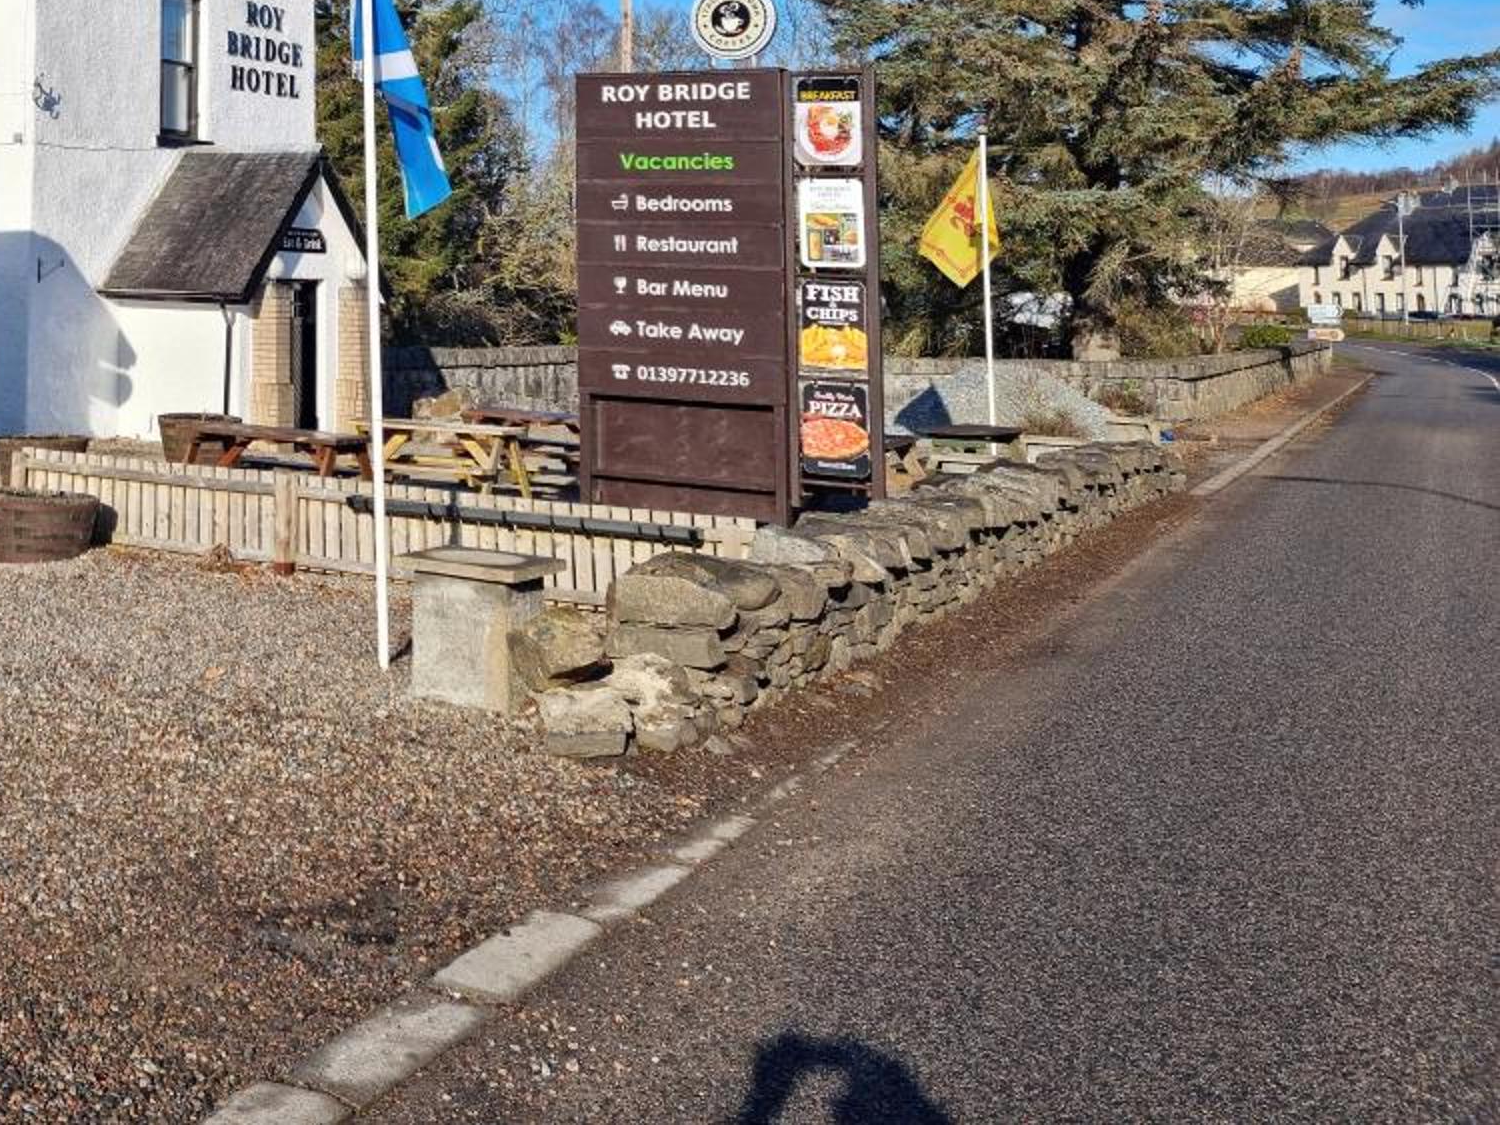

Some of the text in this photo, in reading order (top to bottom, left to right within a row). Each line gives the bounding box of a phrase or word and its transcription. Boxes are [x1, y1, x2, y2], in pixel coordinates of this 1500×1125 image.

[245, 1, 285, 33] ROY
[227, 30, 303, 68] BRIDGE
[231, 65, 299, 99] HOTEL
[602, 81, 751, 103] ROY BRIDGE
[800, 90, 856, 101] BREAKFAST
[635, 110, 717, 129] HOTEL
[619, 152, 735, 170] Vacancies
[635, 194, 734, 213] Bedrooms
[636, 235, 739, 254] Restaurant
[636, 278, 728, 298] Bar Menu
[805, 284, 860, 303] FISH
[806, 307, 859, 322] CHIPS
[636, 321, 745, 345] Take Away
[637, 365, 750, 387] 01397712236
[809, 400, 862, 418] PIZZA
